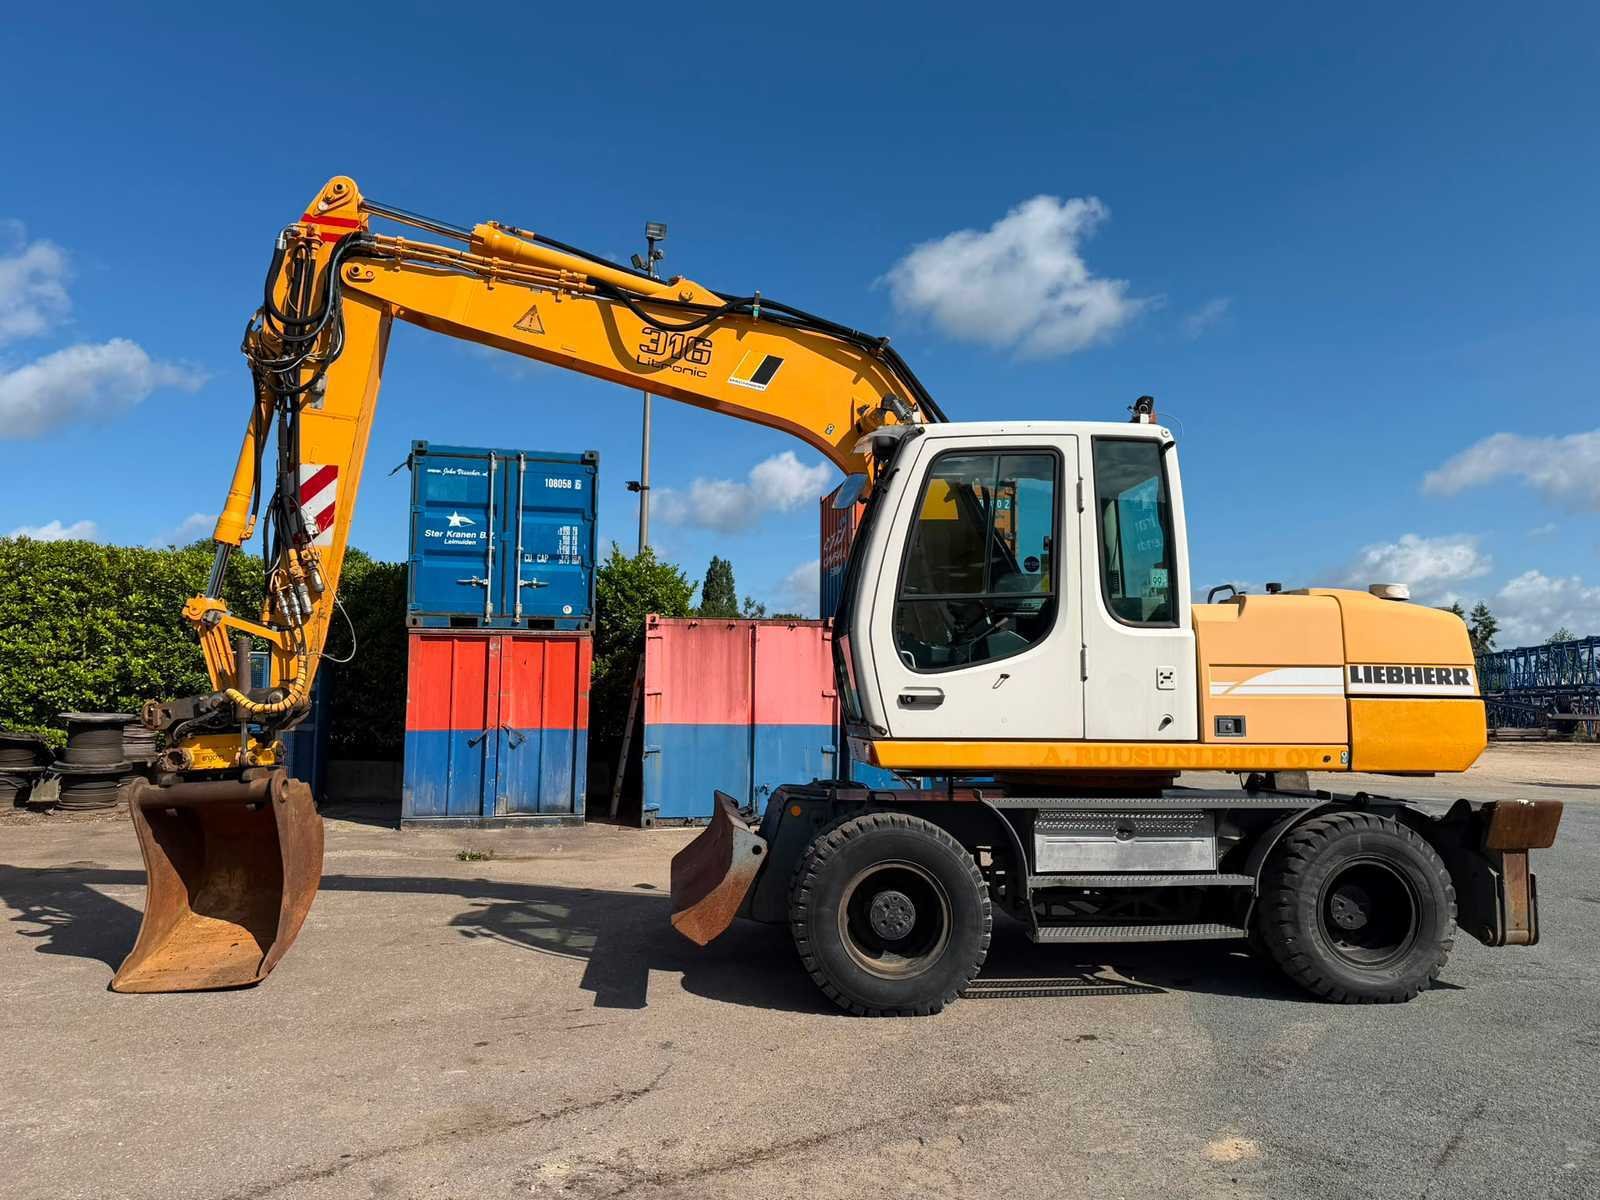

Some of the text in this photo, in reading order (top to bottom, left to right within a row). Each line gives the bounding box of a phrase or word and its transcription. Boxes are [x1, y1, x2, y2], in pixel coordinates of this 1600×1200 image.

[639, 327, 713, 365] 316
[637, 355, 708, 378] Litronic
[544, 478, 572, 489] 108058
[424, 529, 444, 537] Ster
[446, 530, 477, 539] Kranen
[1350, 665, 1471, 686] LIEBHERR
